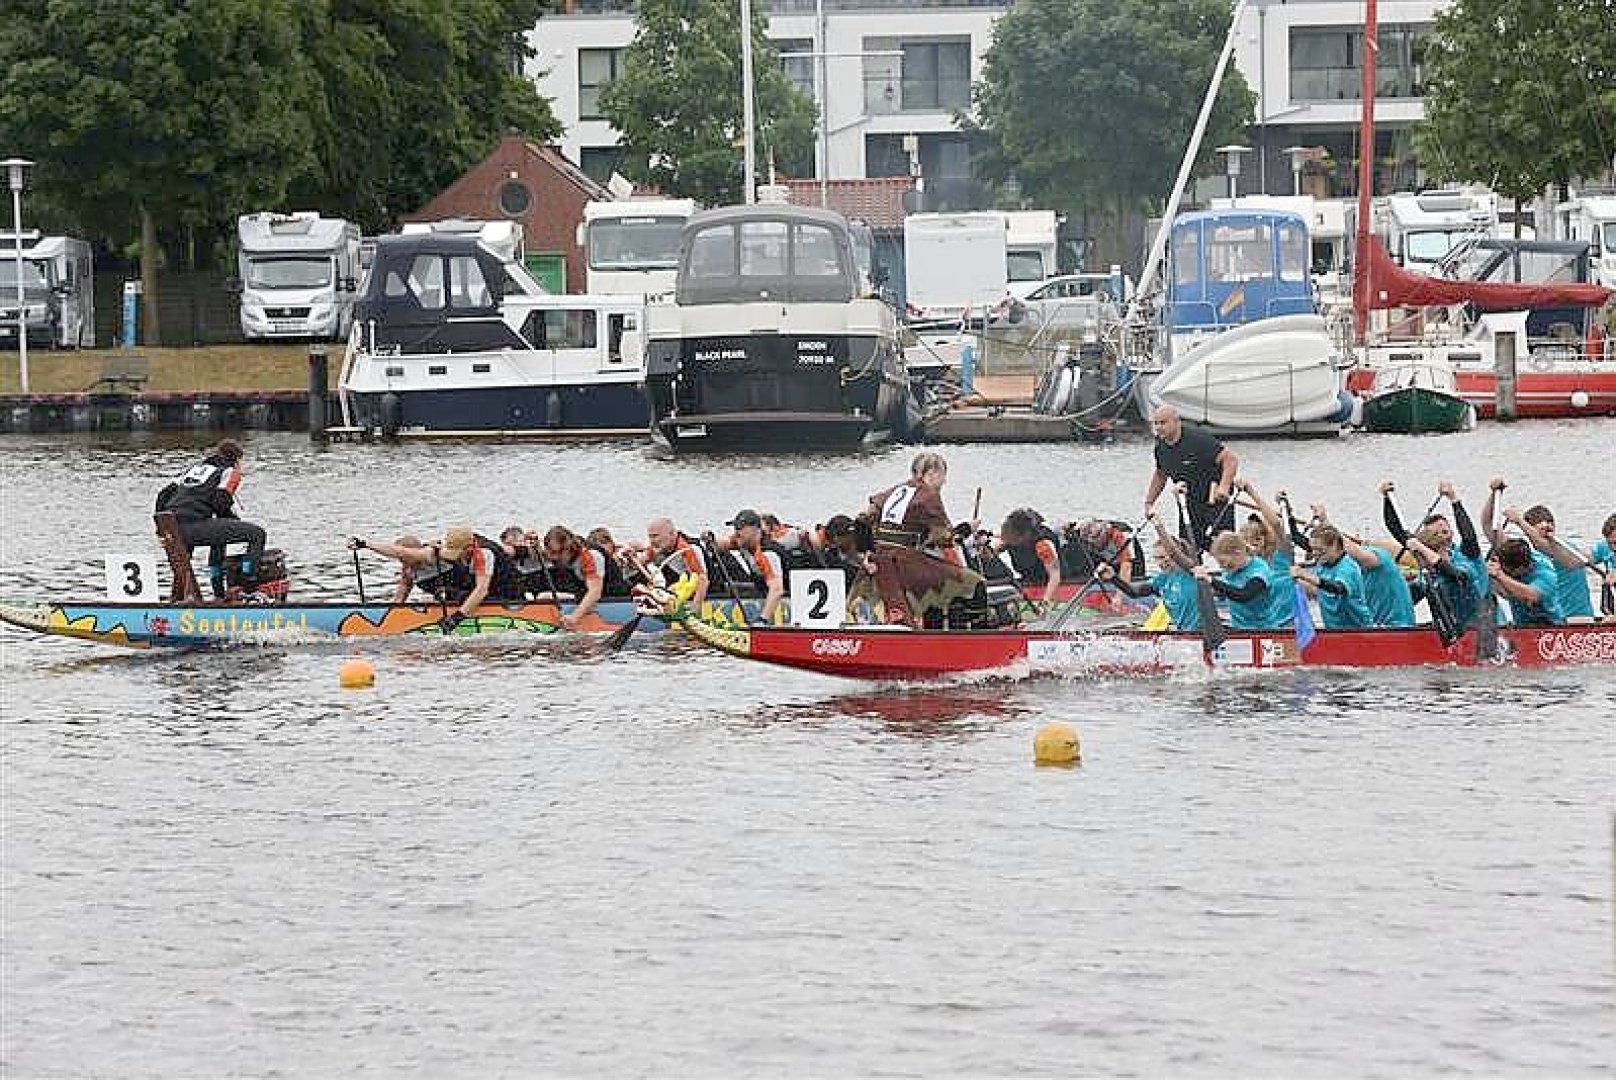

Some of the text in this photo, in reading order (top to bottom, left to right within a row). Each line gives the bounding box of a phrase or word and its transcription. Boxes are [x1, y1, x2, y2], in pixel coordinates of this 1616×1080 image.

[695, 349, 748, 361] BLACK PEARL
[884, 487, 909, 519] 2
[122, 562, 143, 596] 3
[808, 579, 829, 620] 2
